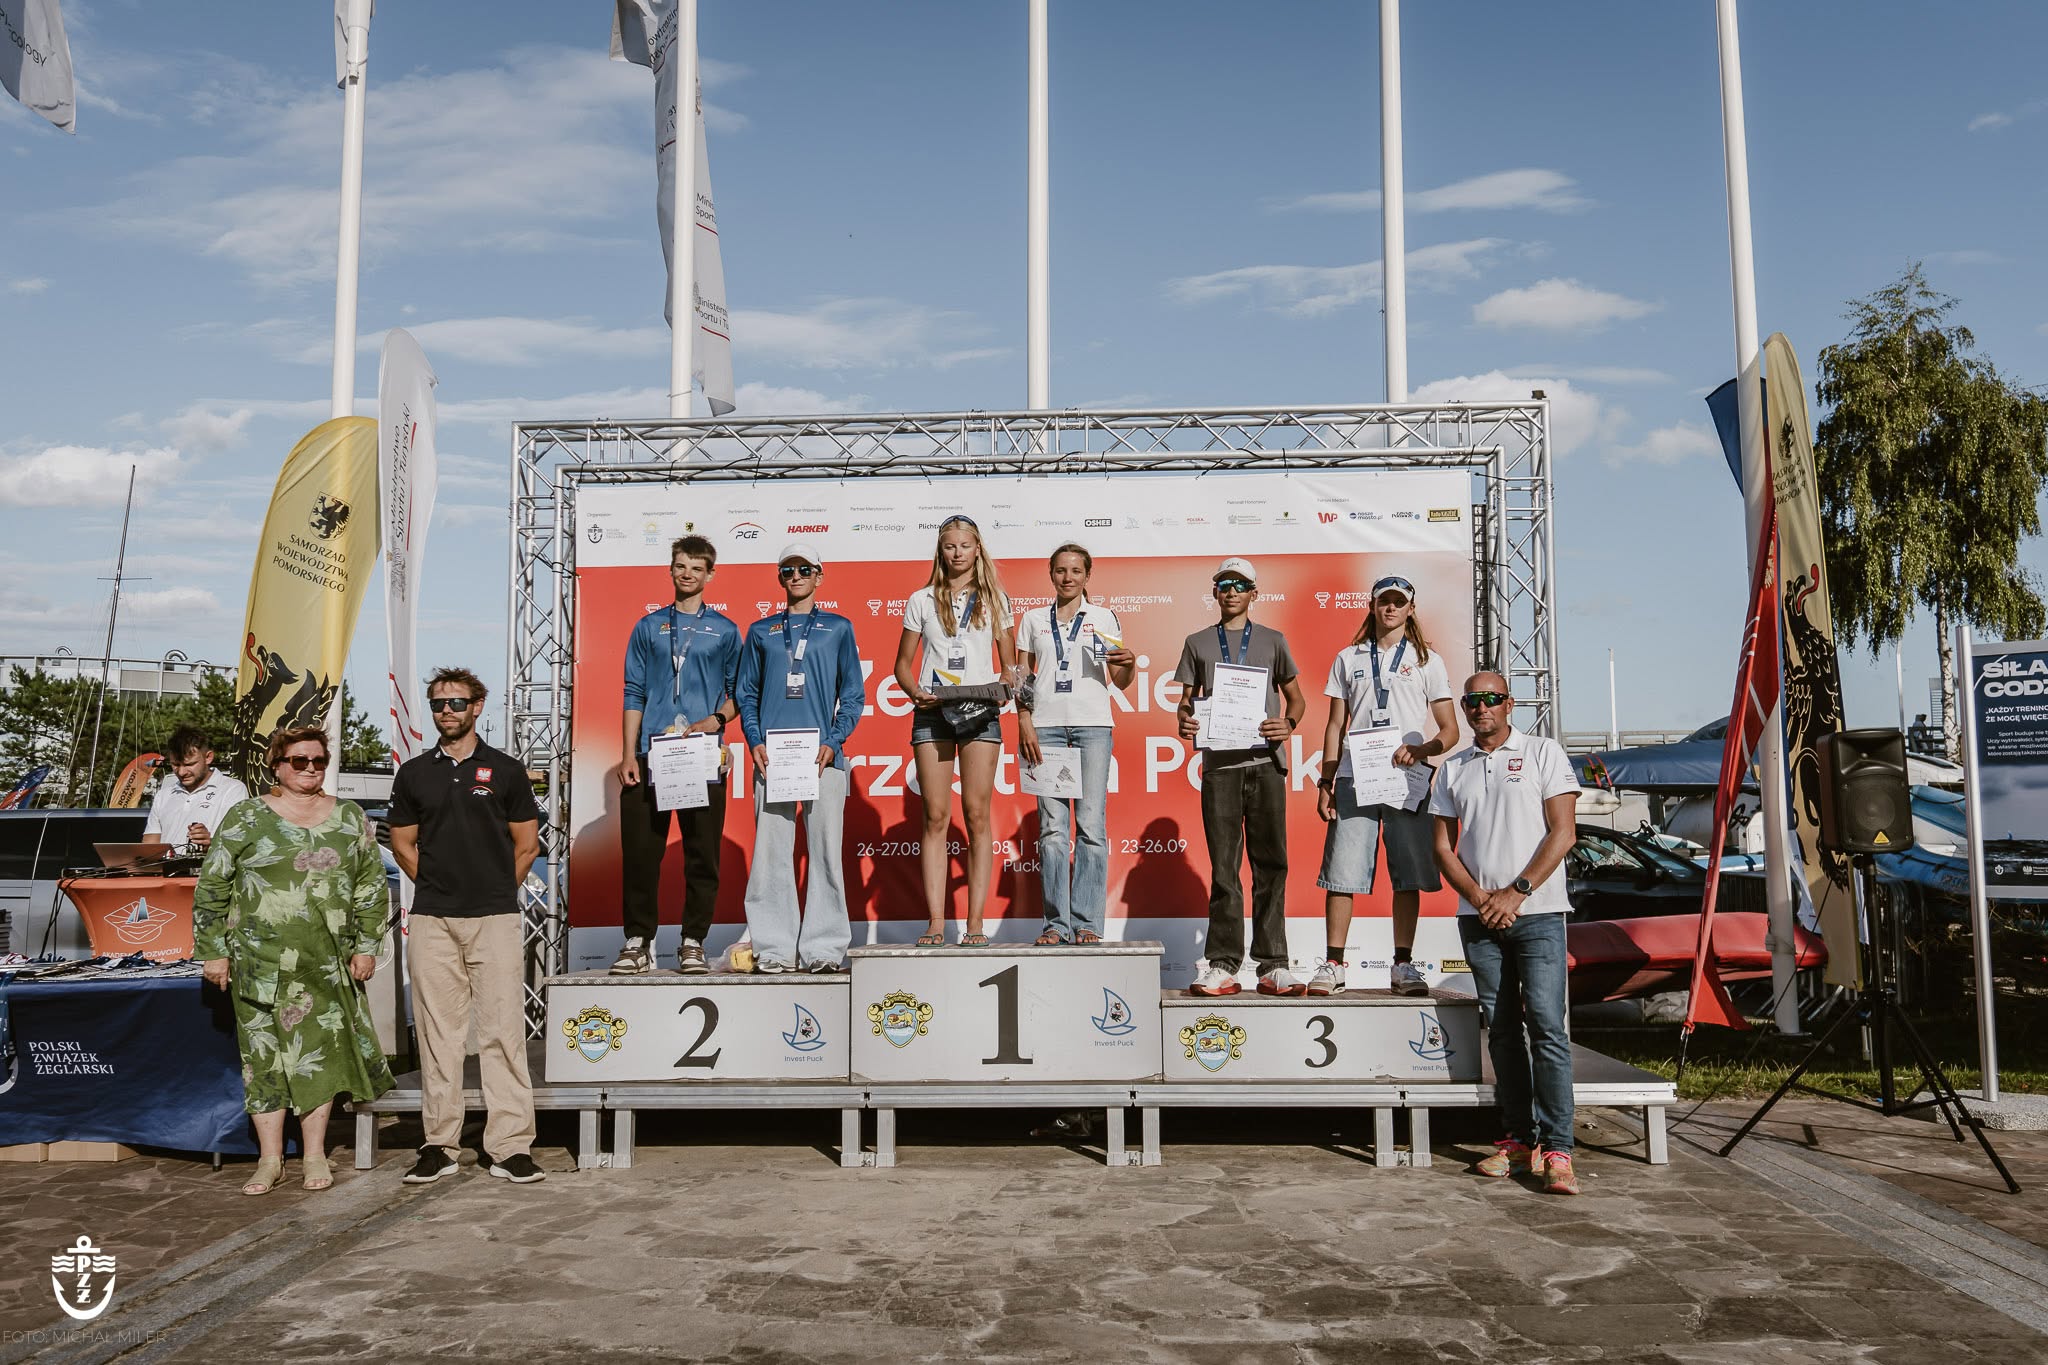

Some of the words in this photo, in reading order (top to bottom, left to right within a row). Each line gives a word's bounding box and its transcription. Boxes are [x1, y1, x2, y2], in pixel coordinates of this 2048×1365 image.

[787, 524, 829, 534] HARKEN
[874, 523, 906, 532] Ecology
[1085, 519, 1111, 527] OSHEE
[735, 530, 759, 540] PGE
[289, 534, 346, 563] SAMORZĄD
[277, 541, 348, 581] WOJEWÓDZTWA
[272, 555, 345, 593] POMORSKIEGO
[1109, 595, 1173, 605] MISTRZOSTWA
[1335, 601, 1367, 610] POLSKI
[857, 842, 920, 856] 26-27.08
[1121, 838, 1188, 854] 23-26.09
[1003, 859, 1040, 872] Puck
[978, 964, 1033, 1065] 1
[673, 996, 721, 1070] 2
[29, 1041, 82, 1051] POLSKI
[1094, 1039, 1115, 1047] Invest
[1117, 1039, 1135, 1047] Puck
[1304, 1014, 1338, 1069] 3
[32, 1053, 100, 1065] ZWIĄZEK
[784, 1055, 805, 1063] Invest
[806, 1055, 824, 1063] Puck
[35, 1063, 115, 1075] ŻEGLARSKI
